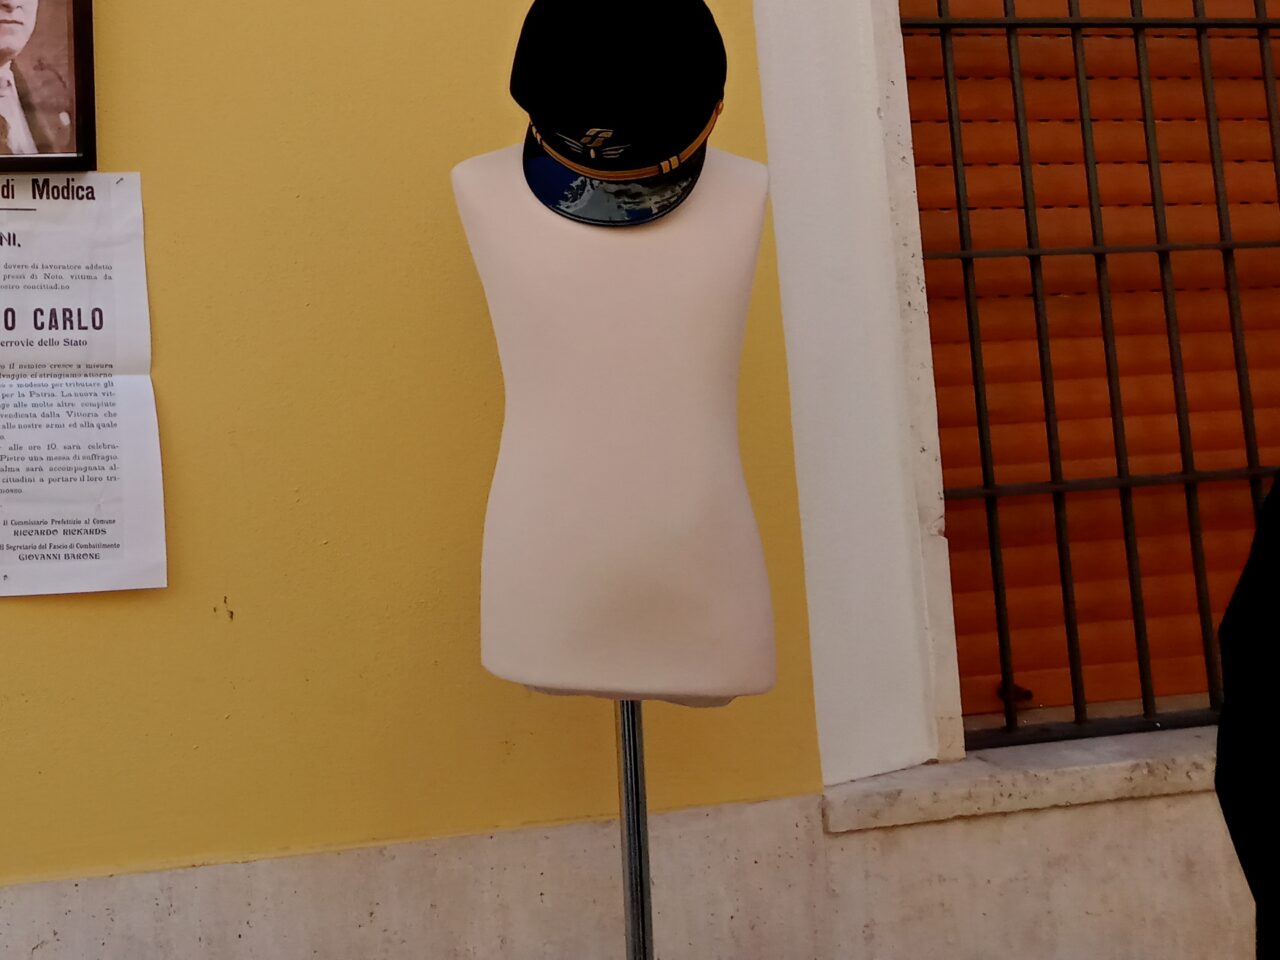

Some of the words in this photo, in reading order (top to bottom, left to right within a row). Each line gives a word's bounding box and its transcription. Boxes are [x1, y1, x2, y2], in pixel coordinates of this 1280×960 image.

[1, 178, 14, 199] di
[32, 177, 96, 201] Modica
[34, 308, 103, 330] CARLO
[38, 338, 59, 346] dello
[63, 338, 87, 346] Stato
[13, 528, 59, 536] RICCARDO
[62, 528, 108, 536] RICKARDS
[18, 553, 61, 561] GIOVANNI
[64, 552, 101, 560] BARONE
